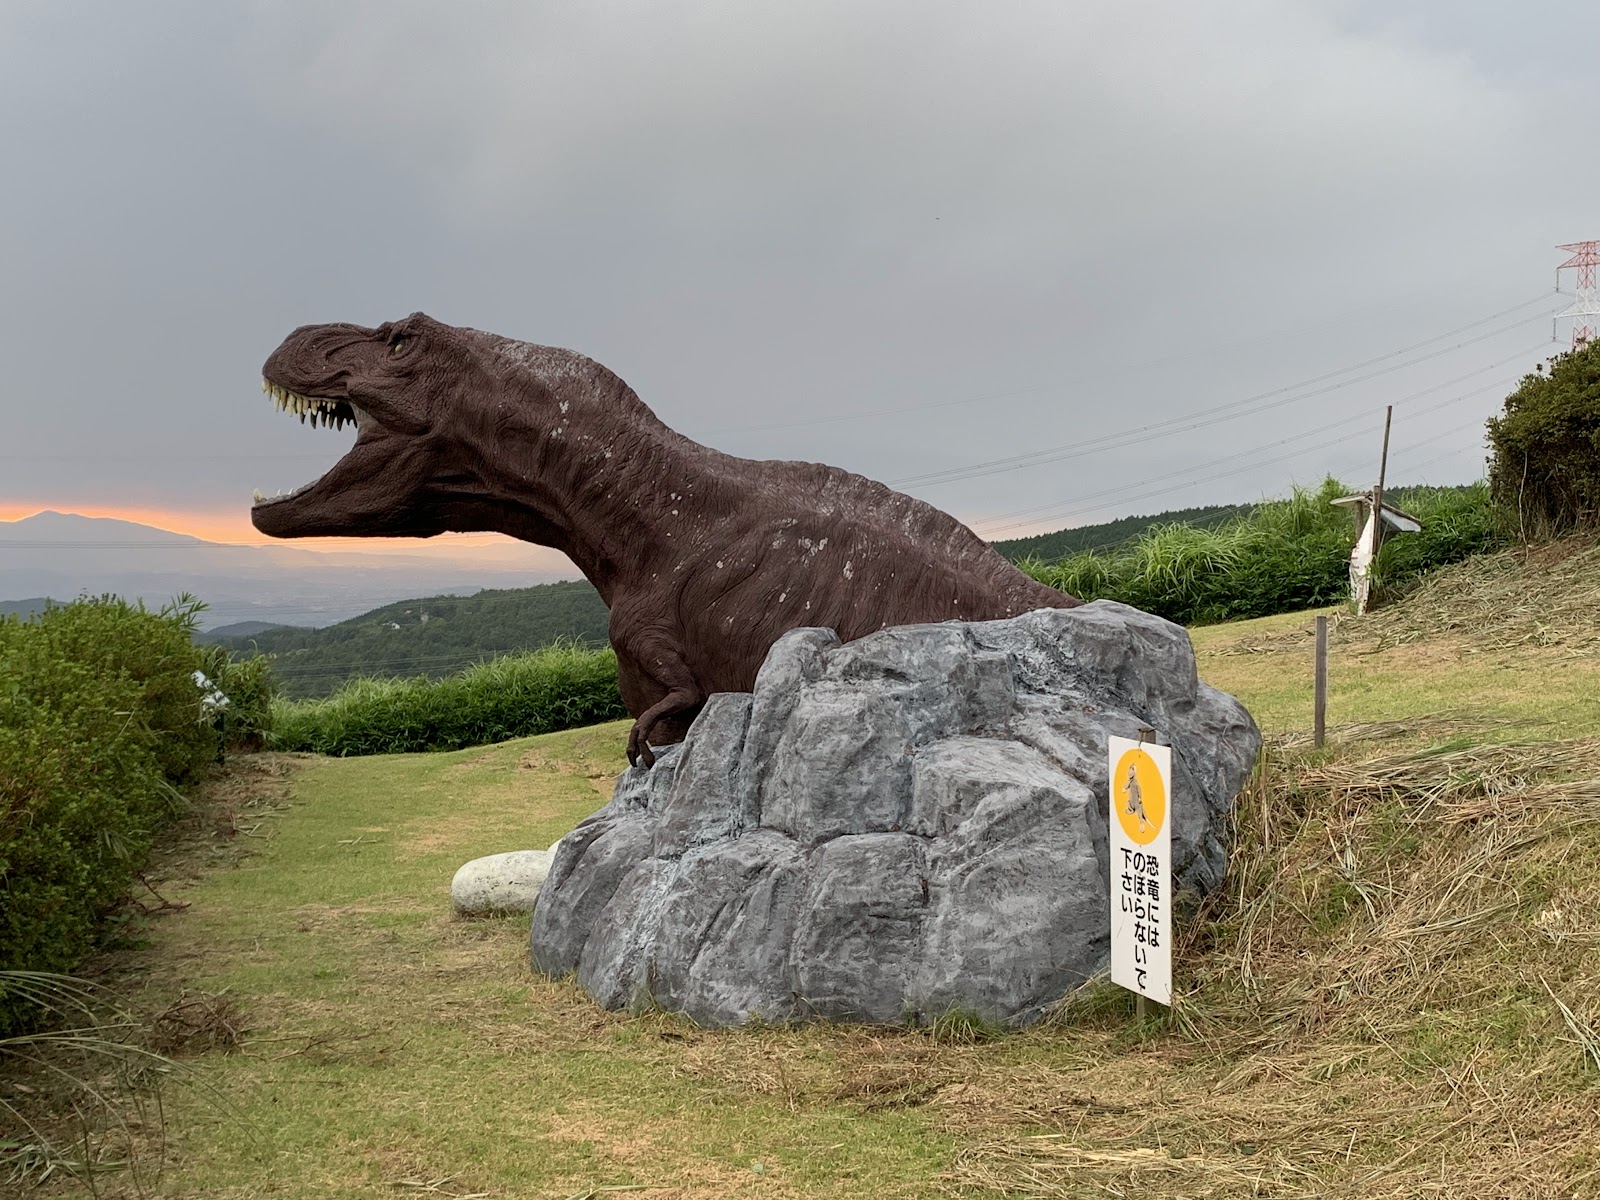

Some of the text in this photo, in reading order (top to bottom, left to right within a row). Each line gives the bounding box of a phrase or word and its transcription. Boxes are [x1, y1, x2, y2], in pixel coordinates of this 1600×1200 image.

[1120, 847, 1133, 913] 下さい
[1133, 852, 1147, 990] のぼらないで
[1146, 854, 1160, 948] 恐竜には
